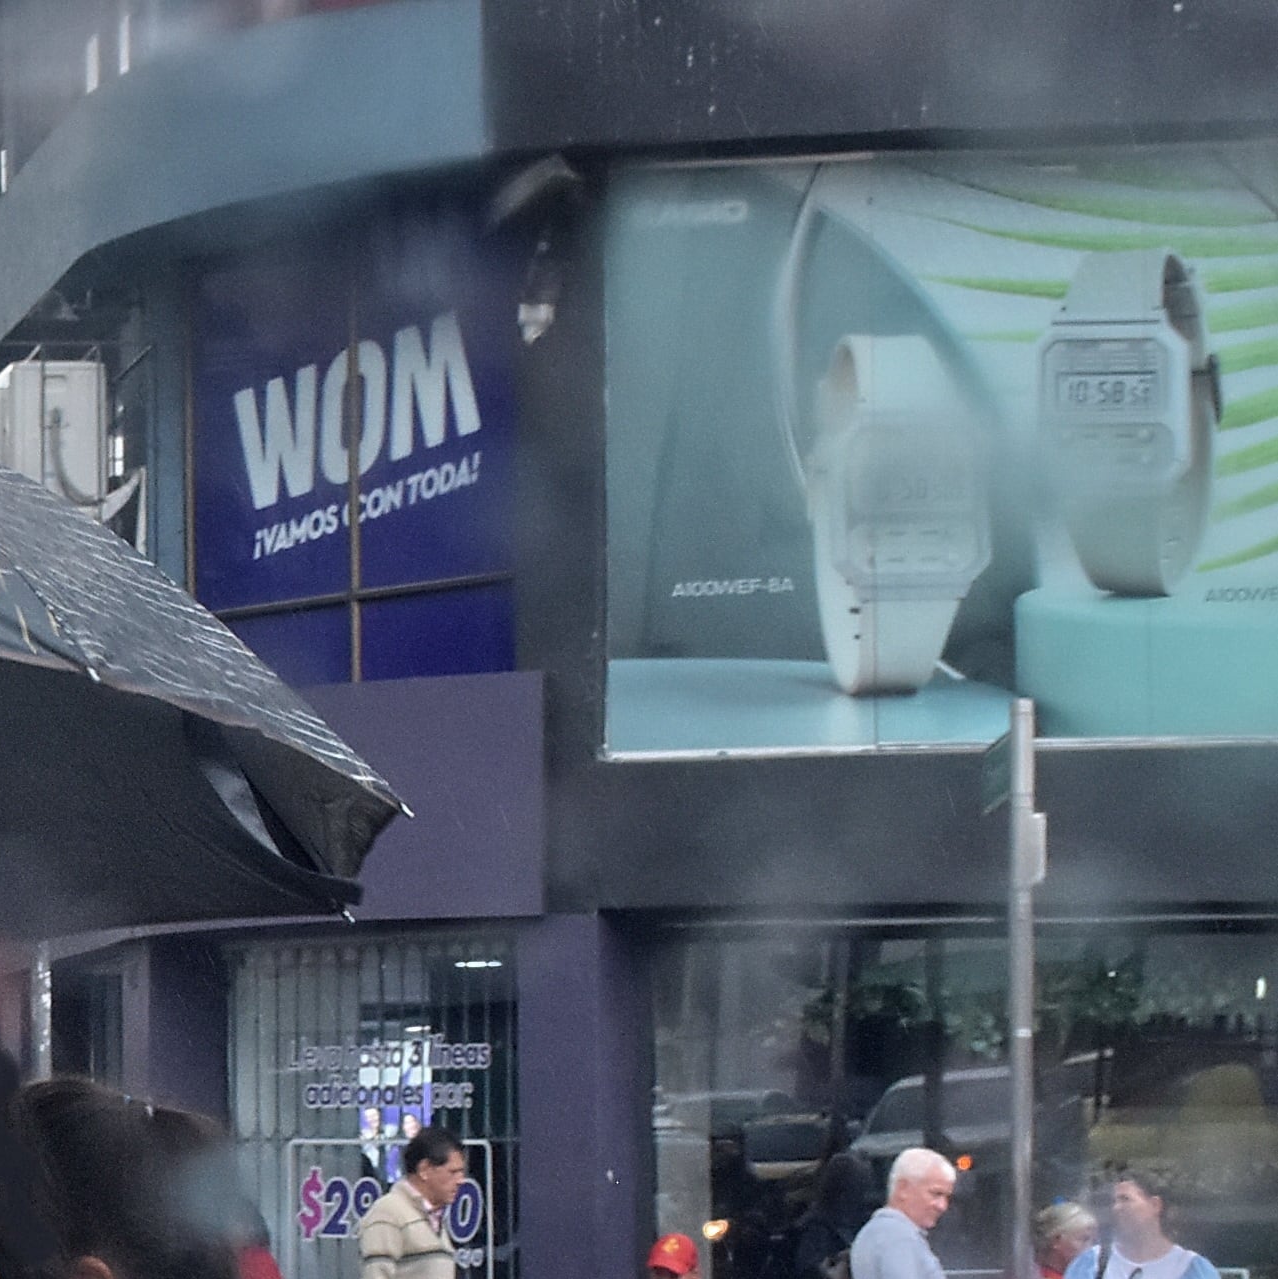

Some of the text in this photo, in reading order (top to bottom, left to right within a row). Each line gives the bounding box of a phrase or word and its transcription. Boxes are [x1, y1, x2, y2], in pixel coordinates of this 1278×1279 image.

[233, 310, 482, 511] WOM
[253, 450, 482, 560] ¡VAMOS CON TODA!
